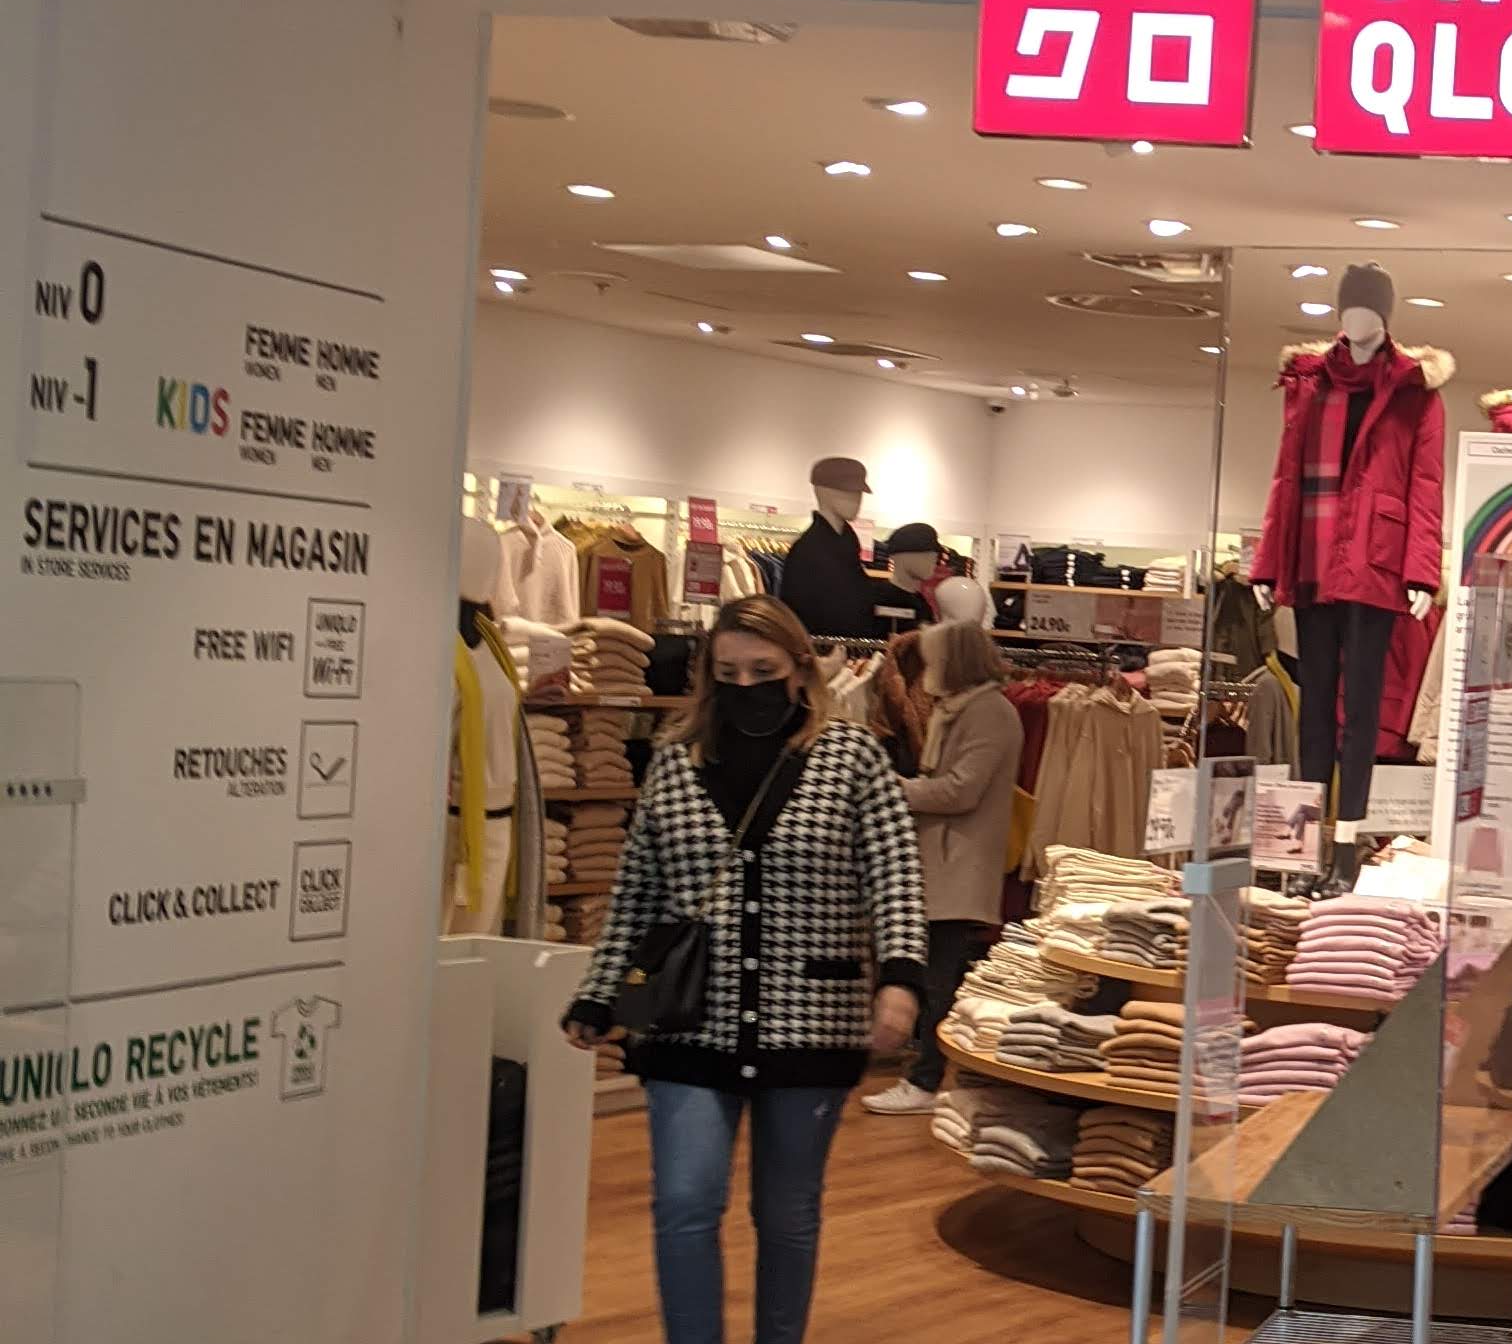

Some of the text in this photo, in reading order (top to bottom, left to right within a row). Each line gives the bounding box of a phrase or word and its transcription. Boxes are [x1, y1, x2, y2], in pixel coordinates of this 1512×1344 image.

[1004, 7, 1215, 106] クロ
[35, 259, 105, 324] NIV 0
[246, 324, 381, 381] FEMME HOMME
[30, 372, 68, 414] NIV
[156, 375, 231, 439] KIDS
[240, 409, 376, 459] FEMME HOMME
[22, 496, 371, 576] SERVICES EN MAGASIN
[194, 628, 294, 662] FREE WIFI
[174, 745, 289, 780] RETOUCHES
[108, 888, 170, 926] CLICK
[191, 878, 281, 918] COLLECT
[126, 1017, 261, 1083] RECYCLE
